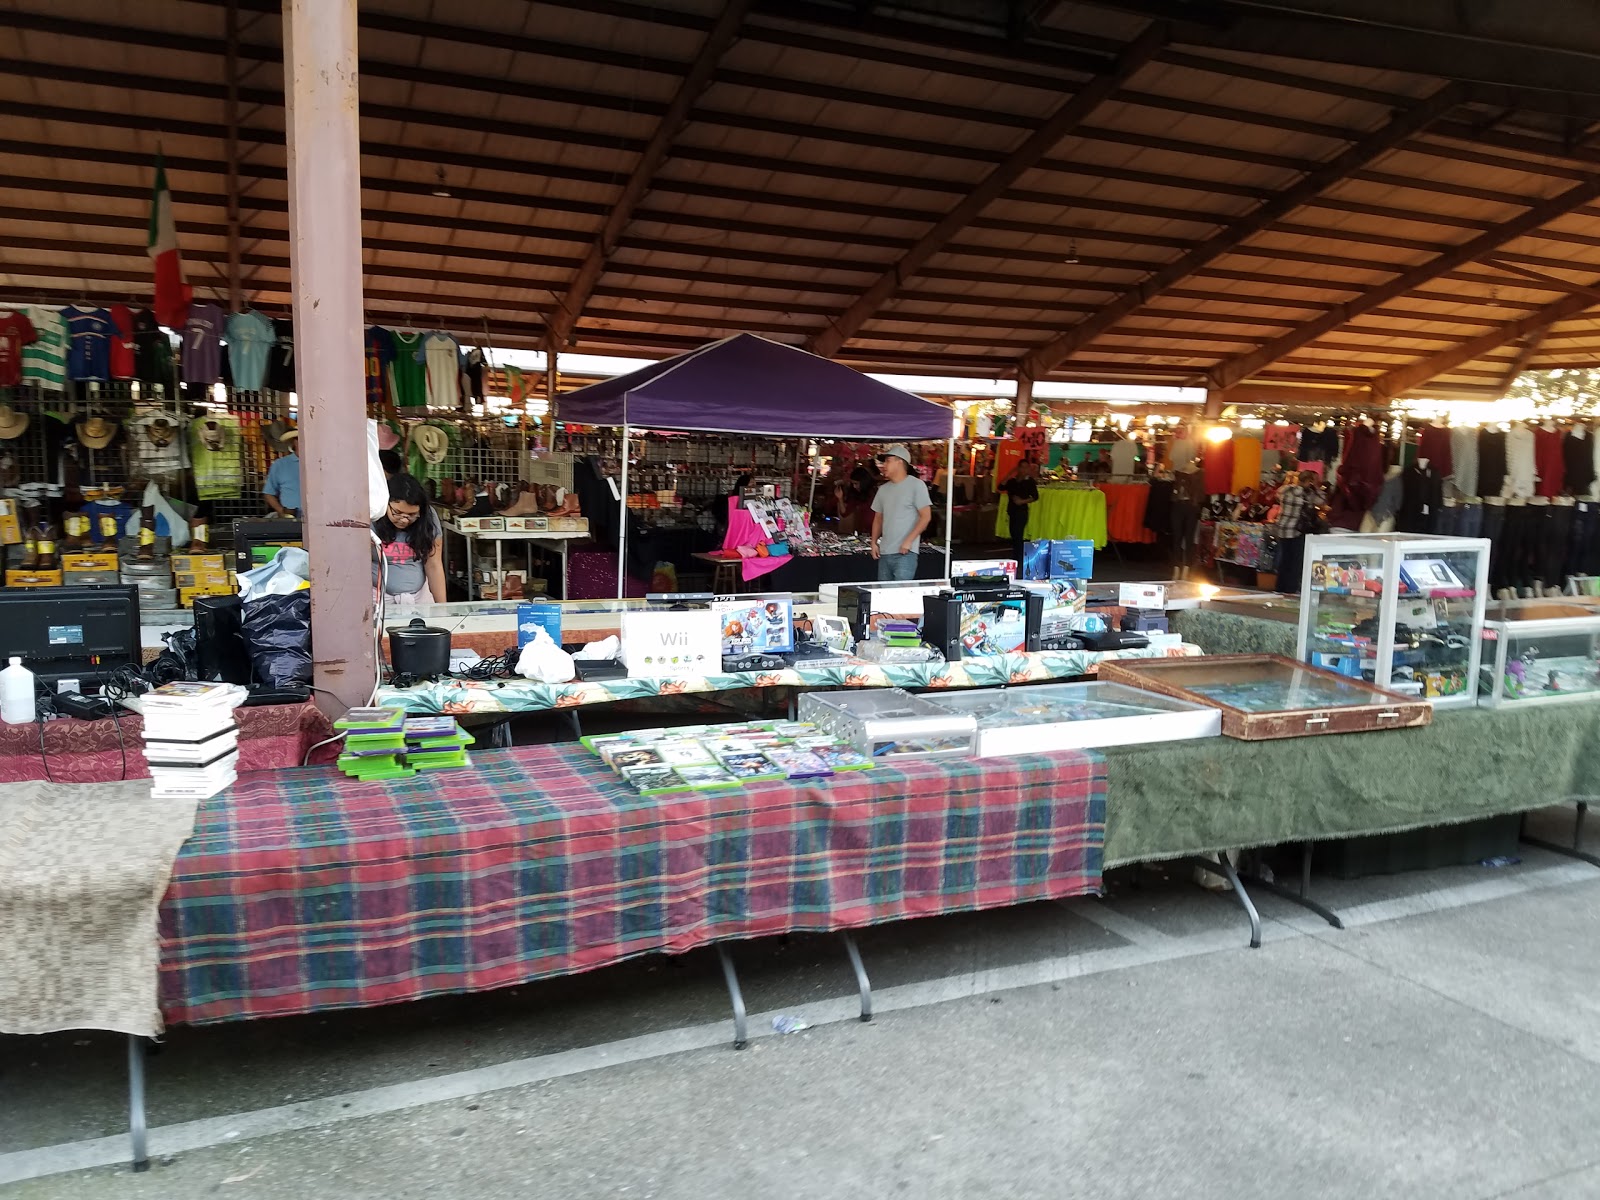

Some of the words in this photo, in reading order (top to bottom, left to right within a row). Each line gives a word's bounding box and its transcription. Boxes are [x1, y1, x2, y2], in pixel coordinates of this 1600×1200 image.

[191, 327, 205, 350] 7
[281, 344, 293, 367] 7
[660, 632, 688, 646] Wii
